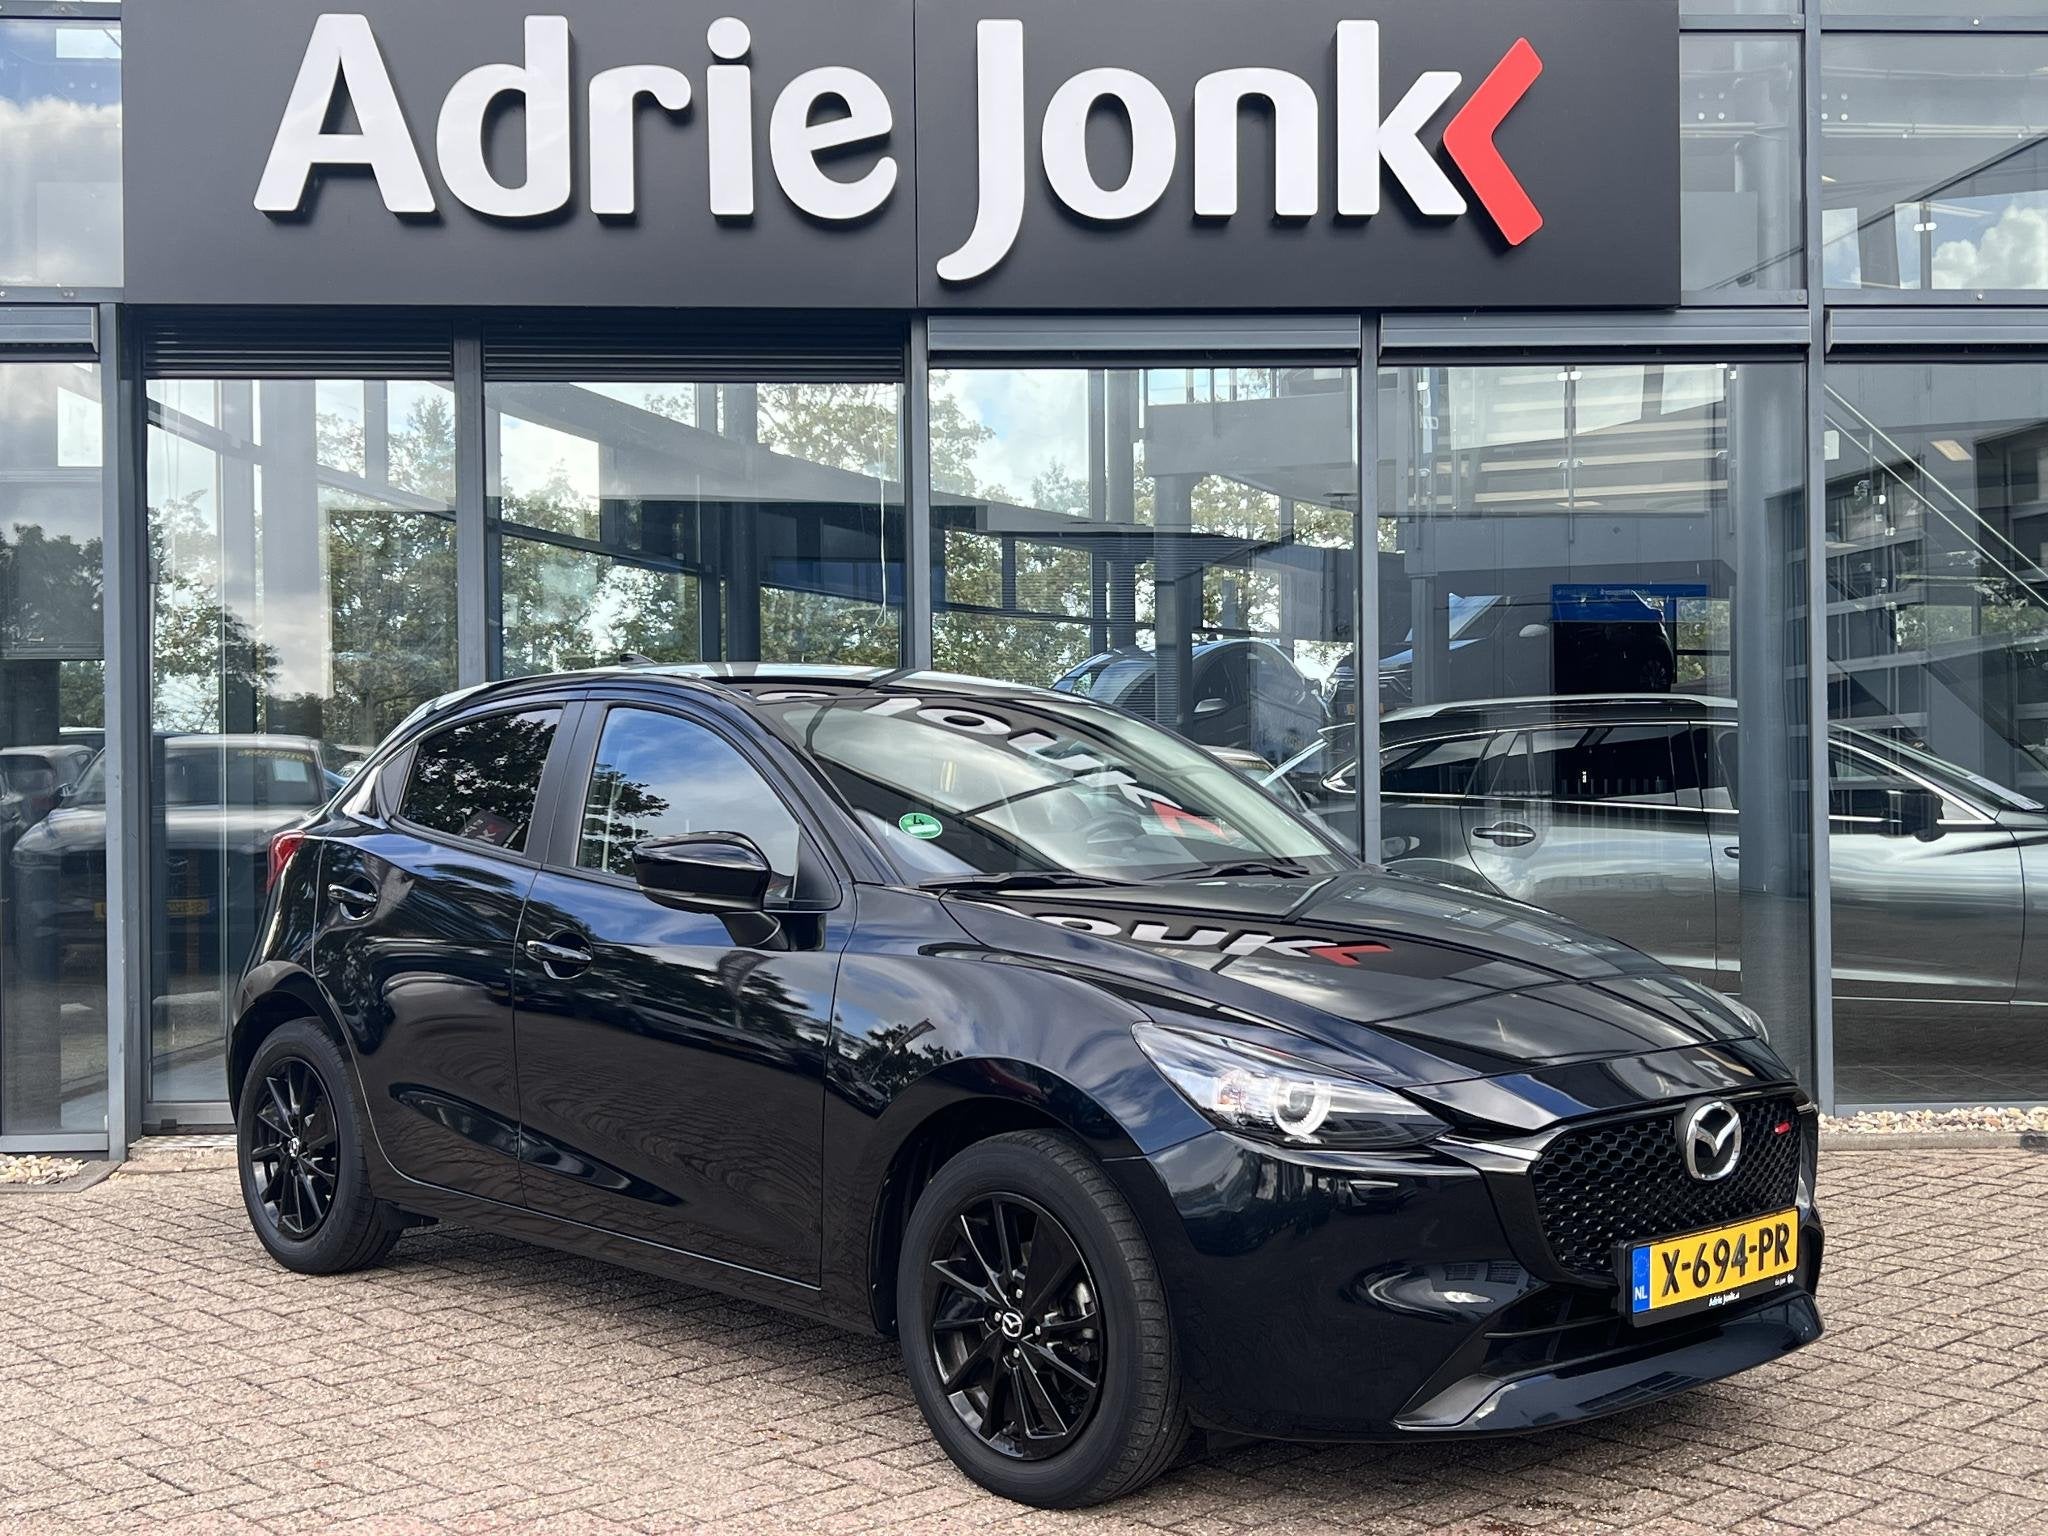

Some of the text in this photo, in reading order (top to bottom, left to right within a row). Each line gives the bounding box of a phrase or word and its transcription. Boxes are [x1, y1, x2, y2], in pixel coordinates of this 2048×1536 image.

[253, 14, 1468, 281] Adrie Jonk
[1634, 1285, 1648, 1300] NL
[1661, 1222, 1790, 1297] X-694-PR
